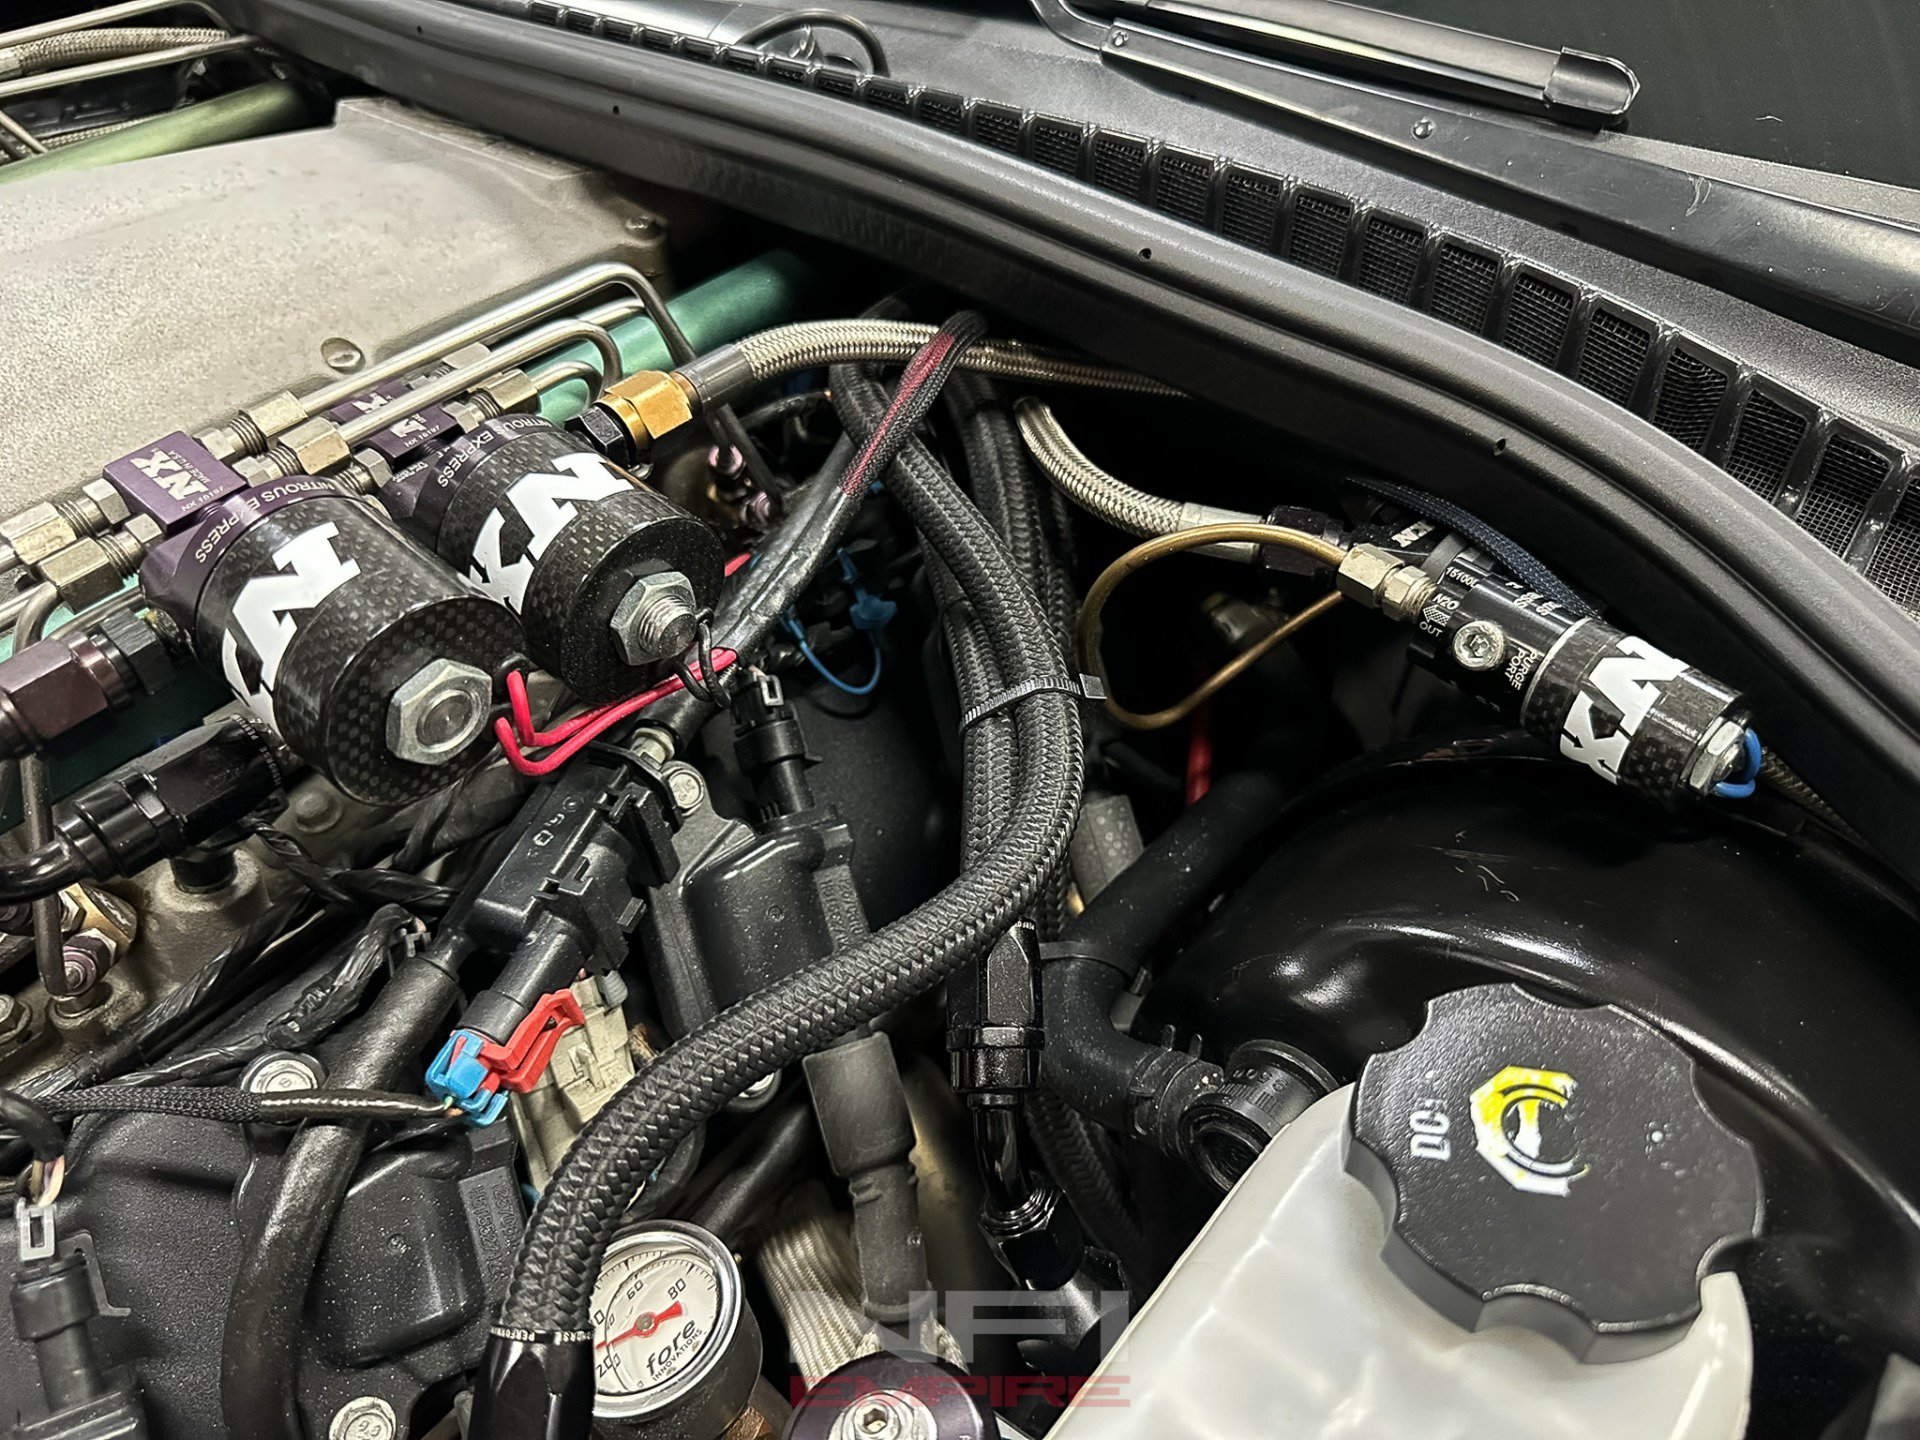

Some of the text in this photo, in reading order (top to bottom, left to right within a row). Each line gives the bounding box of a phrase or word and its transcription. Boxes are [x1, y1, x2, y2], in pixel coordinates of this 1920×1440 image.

[130, 448, 209, 501] NX
[437, 430, 495, 488] EXPRESS
[260, 481, 336, 503] NITROUS
[1432, 593, 1461, 611] N2O
[1418, 621, 1444, 638] OUT
[1504, 647, 1529, 682] PORT
[1511, 648, 1539, 691] PURGE
[626, 1279, 644, 1301] 60
[667, 1277, 687, 1301] 80
[645, 1319, 696, 1377] fore
[651, 1328, 704, 1382] INNOVATIONS
